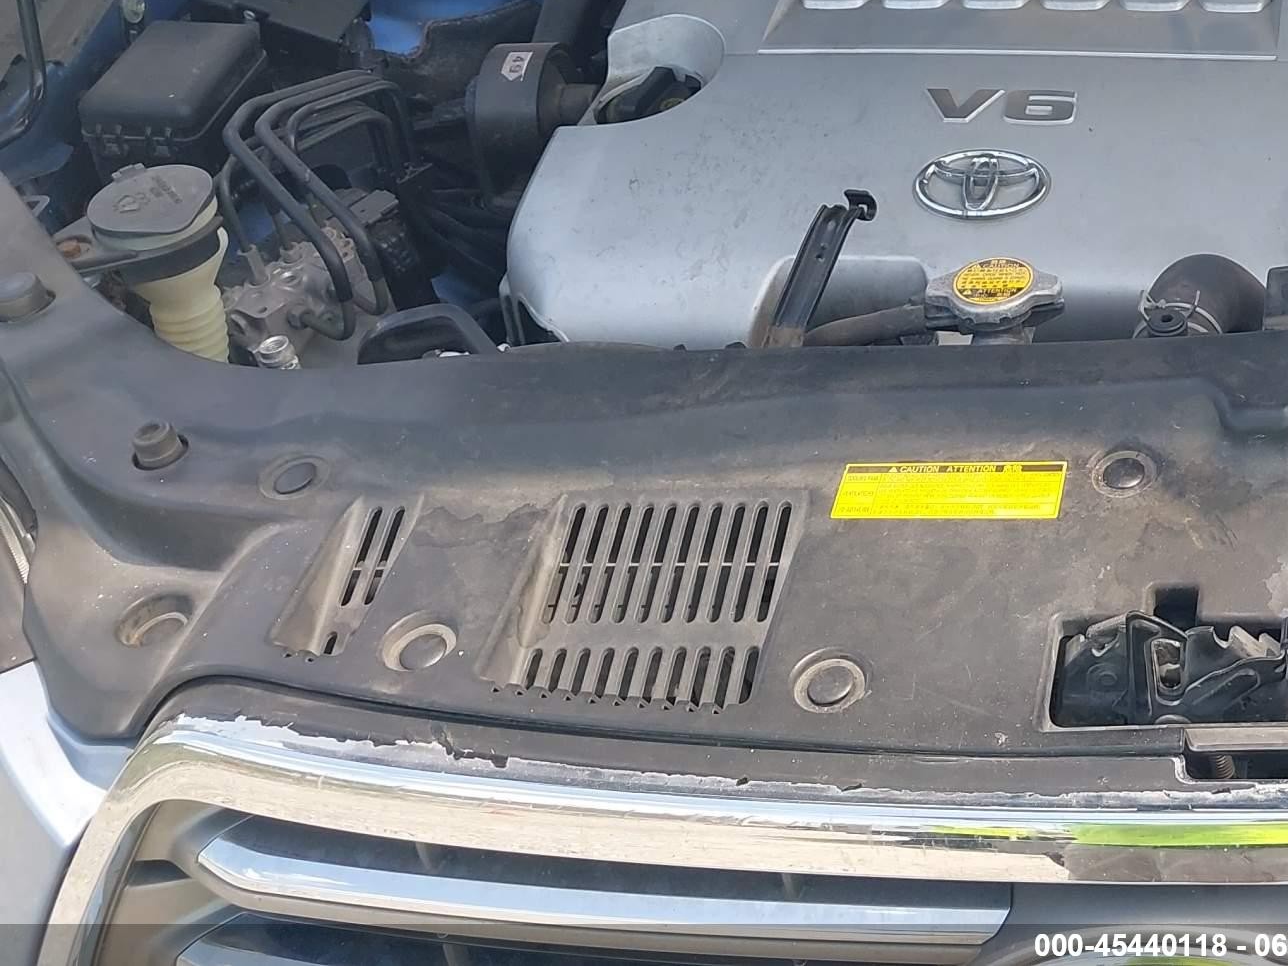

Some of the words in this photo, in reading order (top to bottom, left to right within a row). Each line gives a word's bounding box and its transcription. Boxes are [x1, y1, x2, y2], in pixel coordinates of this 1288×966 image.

[926, 88, 1078, 126] V6
[899, 465, 940, 473] CAUTION
[945, 464, 996, 473] ATTENTION
